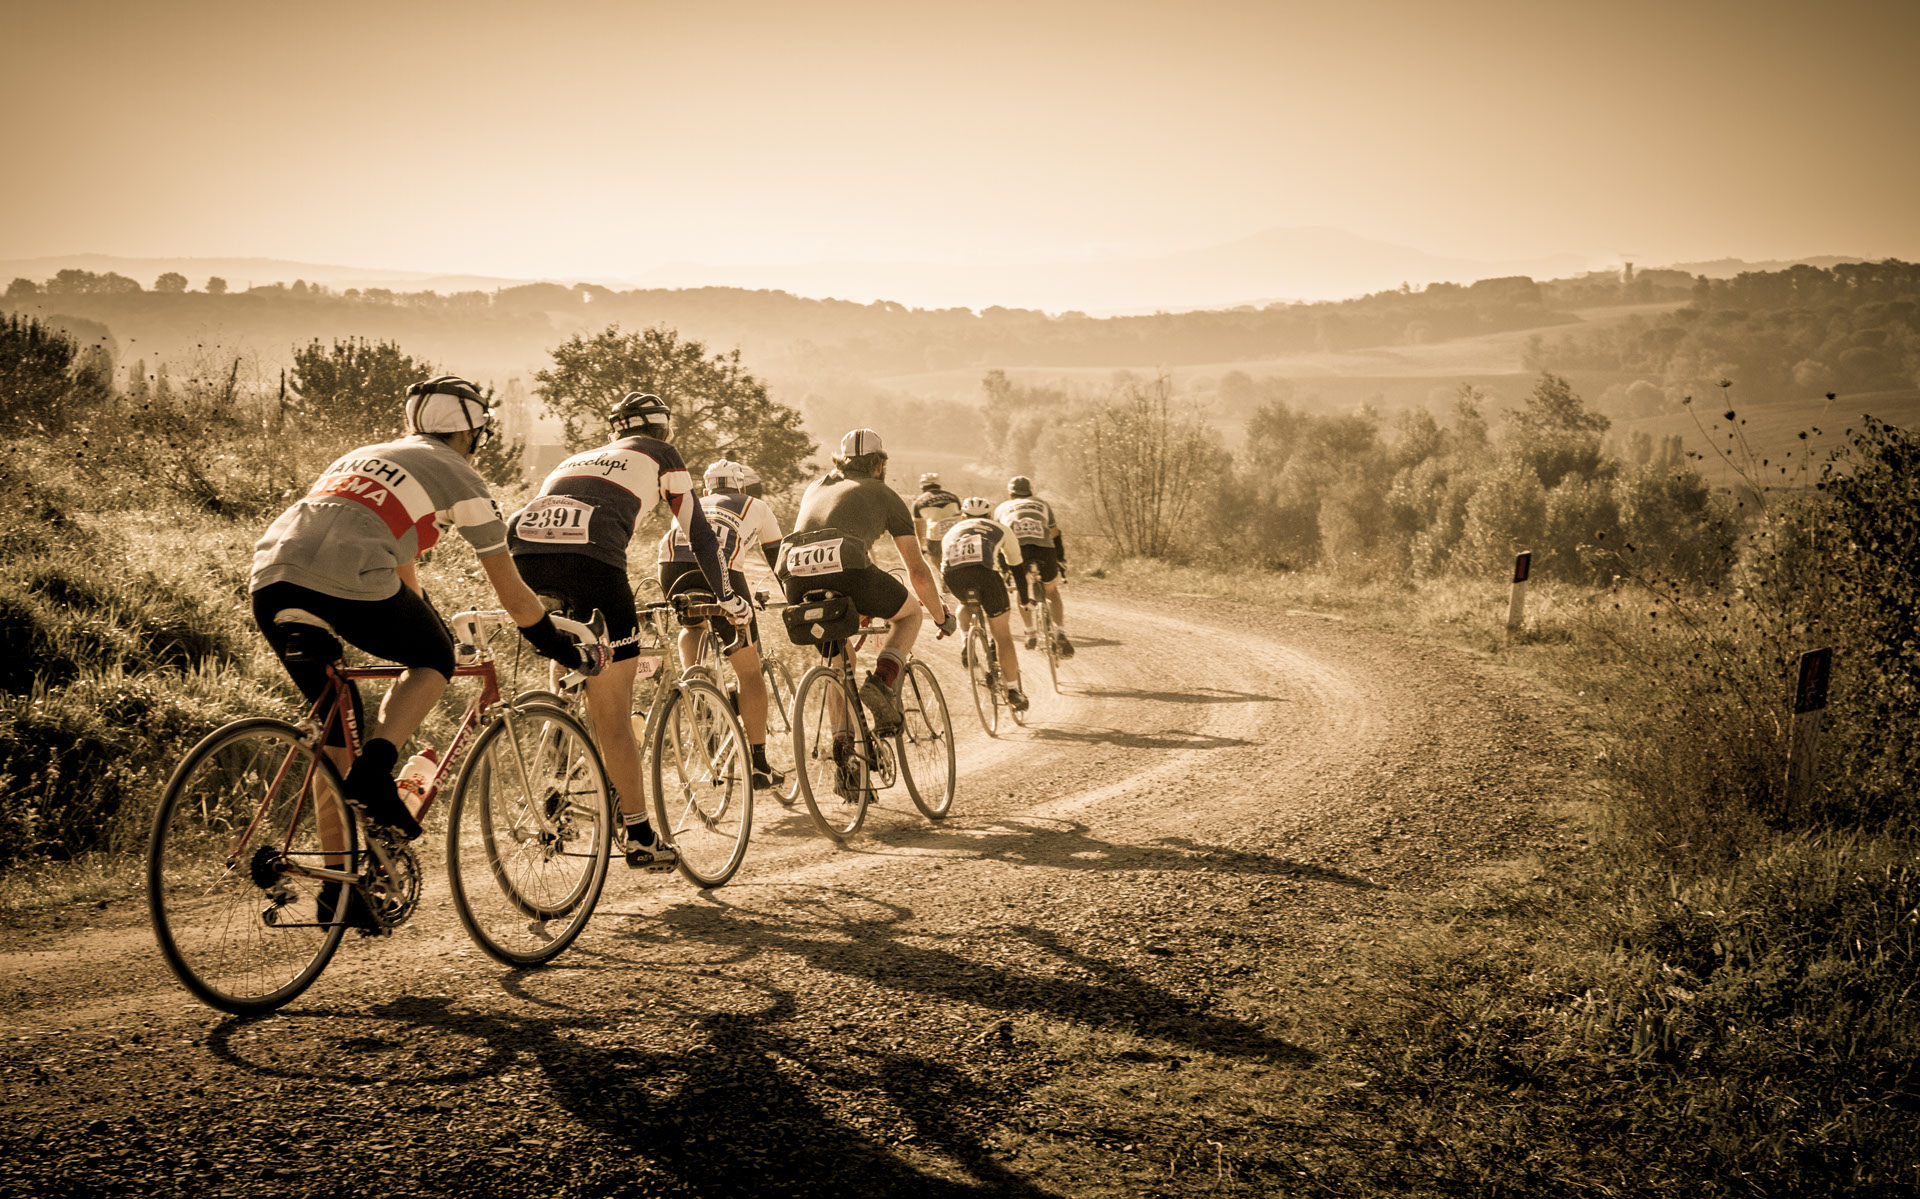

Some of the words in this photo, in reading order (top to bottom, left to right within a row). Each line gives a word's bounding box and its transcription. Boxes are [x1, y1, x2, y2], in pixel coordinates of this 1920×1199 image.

[555, 452, 628, 476] ancolupi
[521, 507, 582, 528] 2391
[789, 545, 837, 567] 4707
